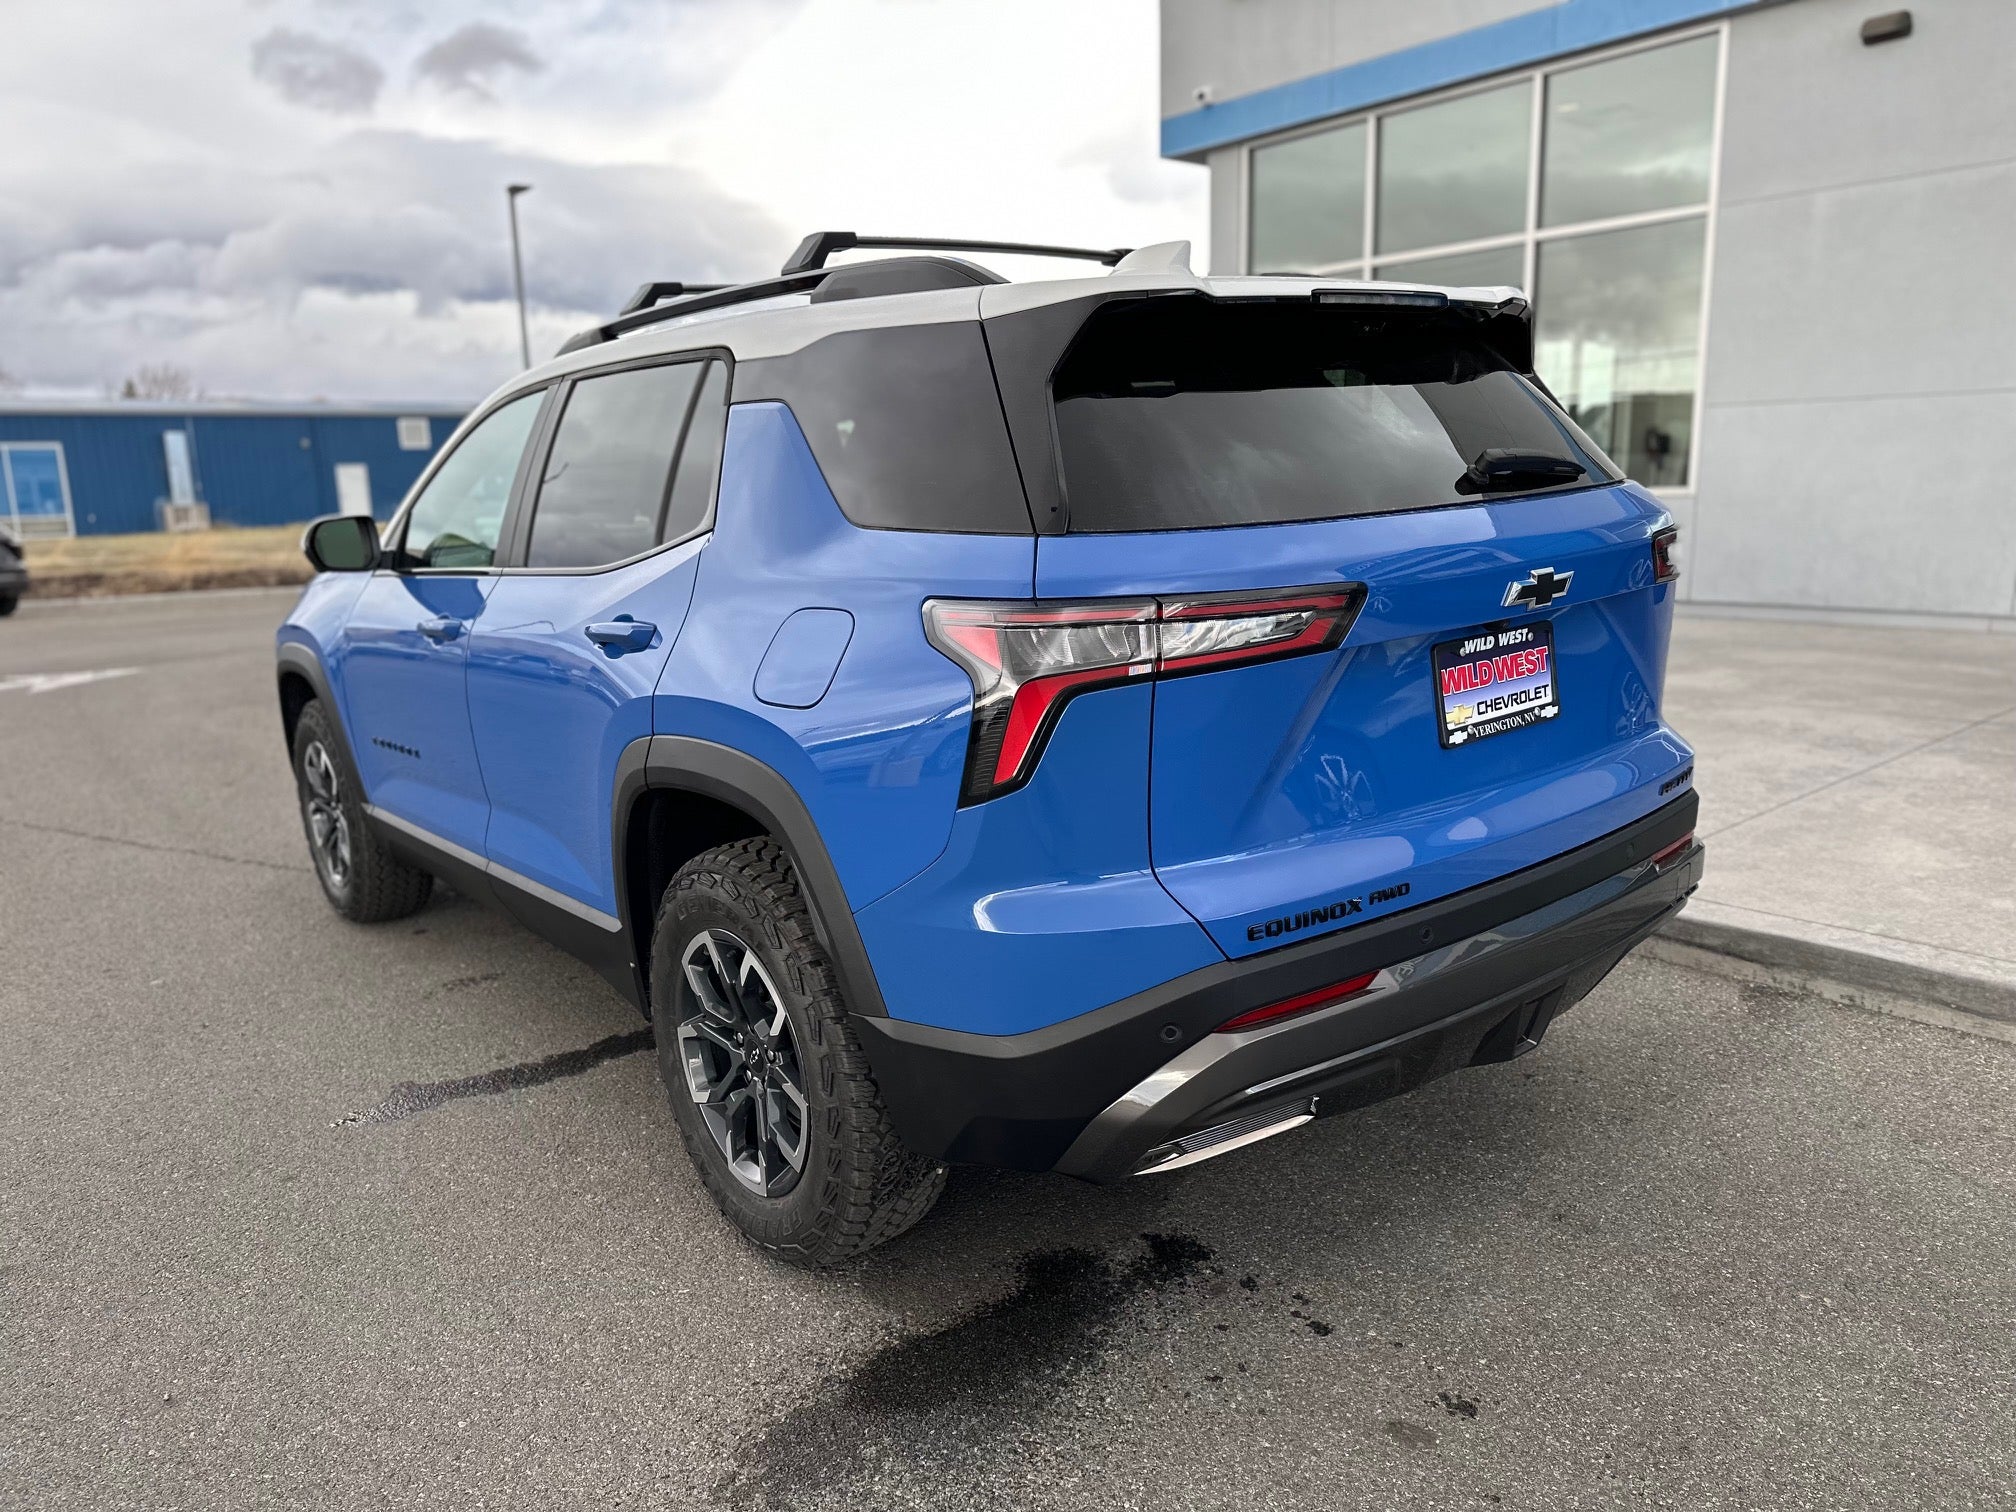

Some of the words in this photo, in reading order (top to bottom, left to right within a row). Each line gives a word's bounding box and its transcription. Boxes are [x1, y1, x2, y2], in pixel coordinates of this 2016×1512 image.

[1464, 635, 1495, 654] WILD
[1498, 628, 1528, 646] WEST
[1477, 684, 1549, 715] CHEVROLET
[1473, 715, 1524, 738] YERINGTON,
[1246, 897, 1363, 942] EQUINOX
[1368, 882, 1411, 906] AWD
